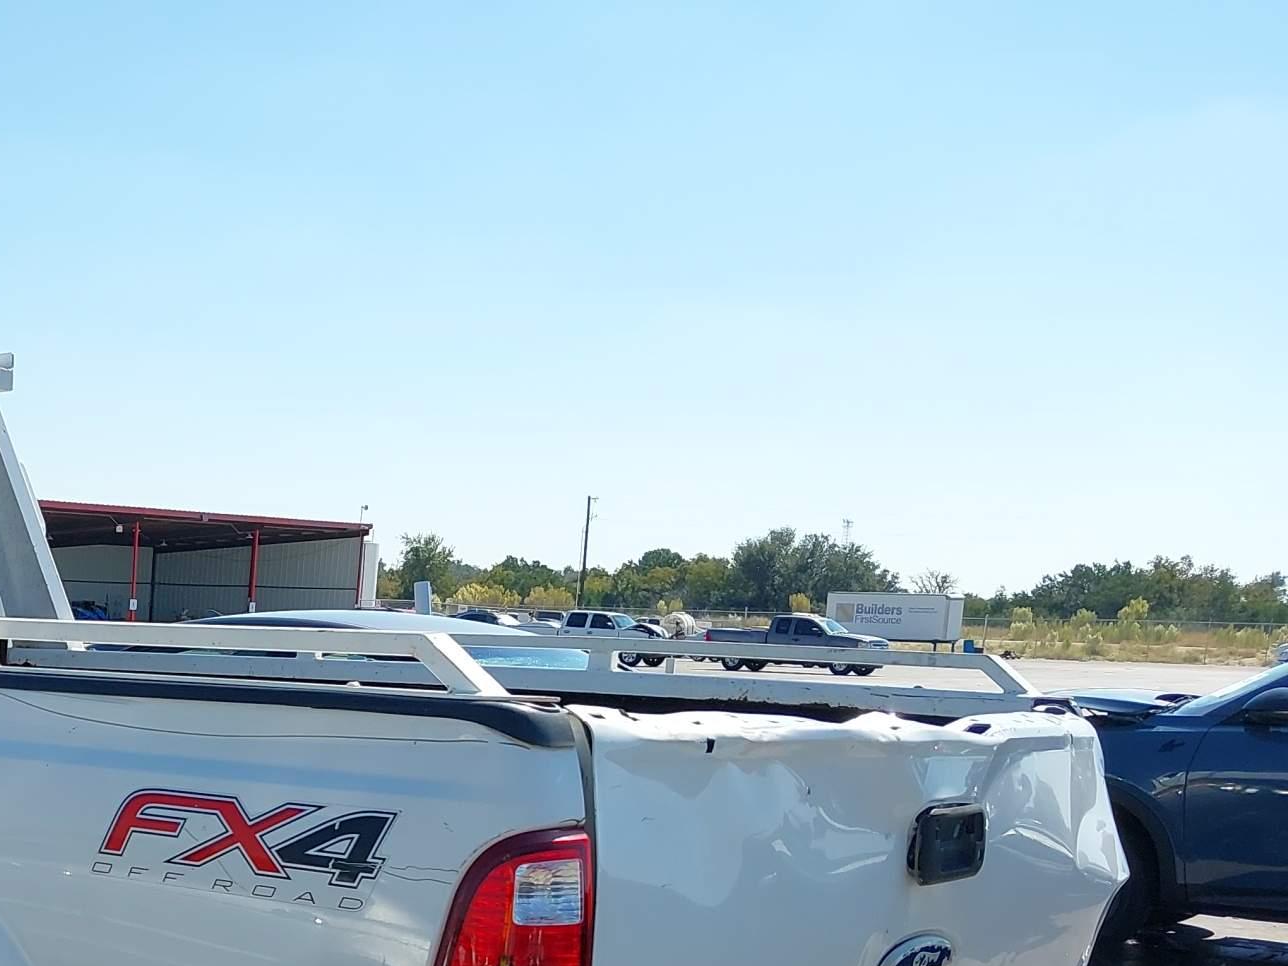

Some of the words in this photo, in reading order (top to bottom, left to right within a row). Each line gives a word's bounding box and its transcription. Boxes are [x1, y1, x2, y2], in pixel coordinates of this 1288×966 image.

[855, 602, 903, 615] Builders
[854, 614, 902, 625] FirstSource
[99, 788, 398, 889] FX4
